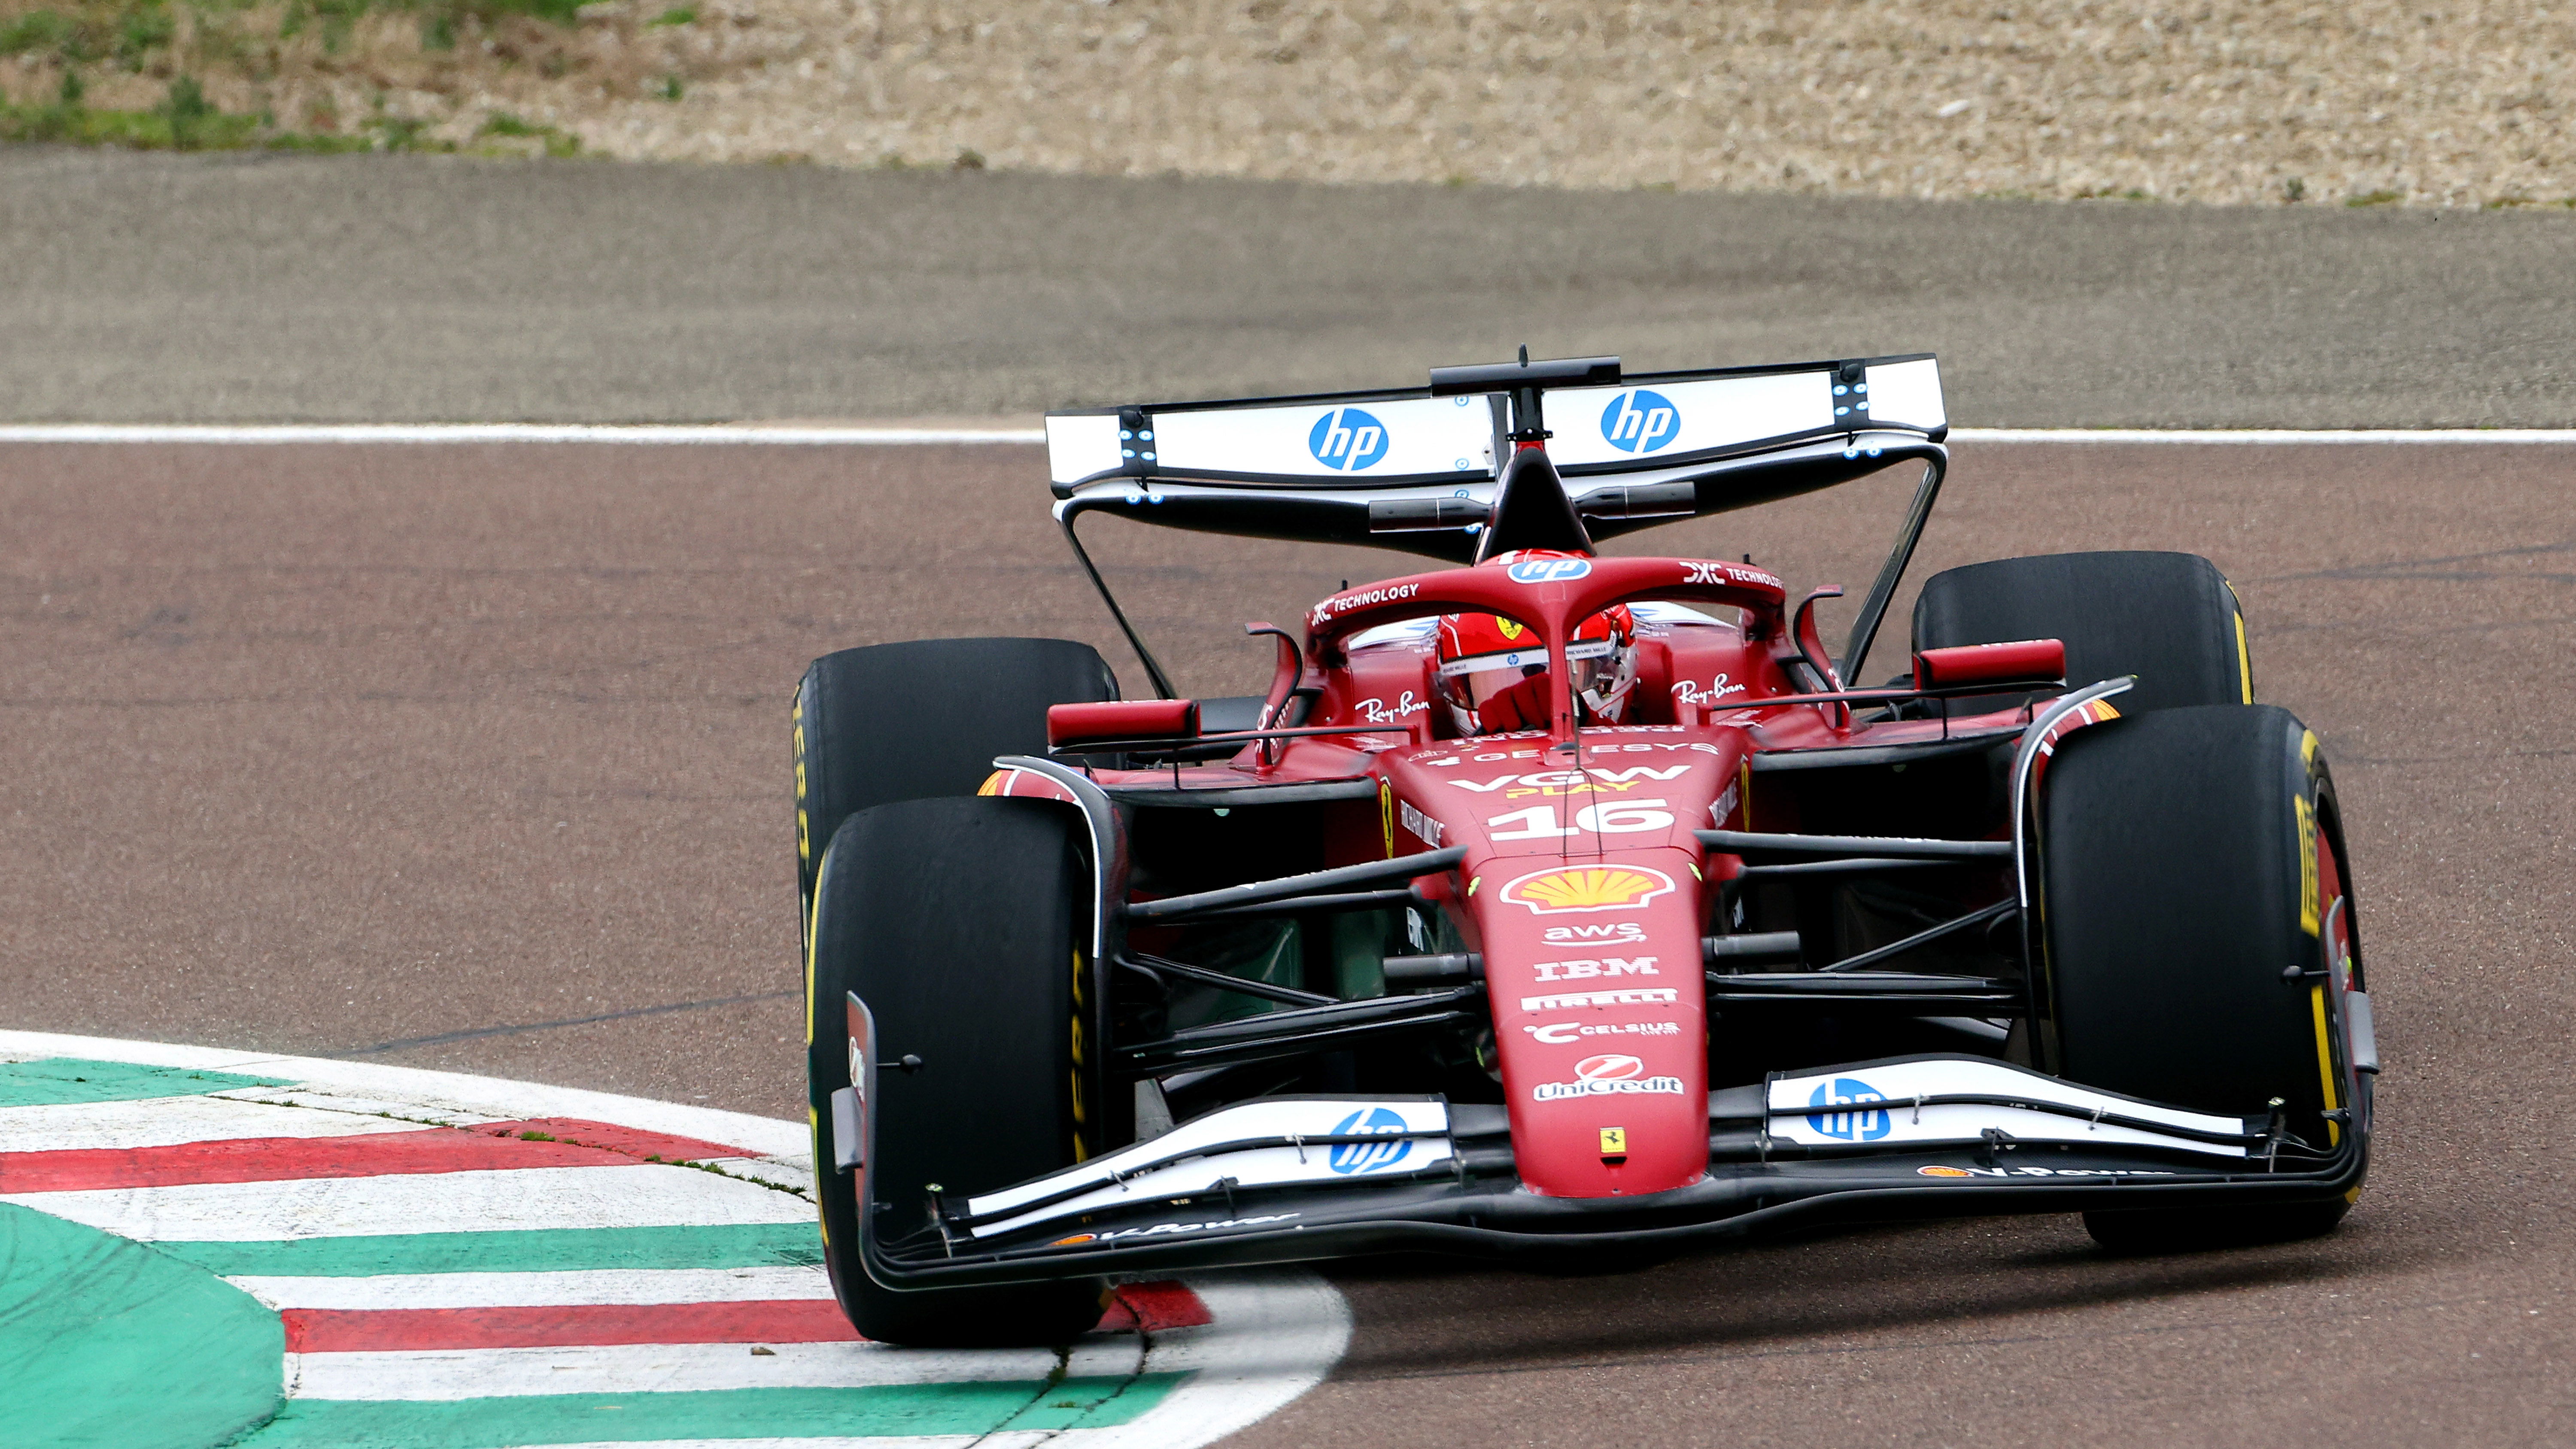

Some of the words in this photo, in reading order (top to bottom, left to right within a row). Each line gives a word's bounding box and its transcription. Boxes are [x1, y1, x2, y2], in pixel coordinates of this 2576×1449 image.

[1616, 390, 1673, 453] hp
[1318, 408, 1381, 471] hp
[1518, 559, 1584, 580] hp
[1726, 568, 1784, 589] TECHNOLO
[1334, 583, 1419, 612] TECHNOLOGY
[1671, 673, 1746, 704] Ray-Ban
[1355, 690, 1430, 723] Ray-Ban
[1473, 742, 1719, 762] GEESYS
[1447, 764, 1693, 793] VGW
[1505, 781, 1640, 799] PLAY
[1487, 798, 1676, 841] 16
[1543, 922, 1643, 940] aws
[1533, 957, 1660, 982] IBM
[1520, 988, 1678, 1012] PIRELLI
[1579, 1022, 1681, 1035] CELSIUS
[1537, 1078, 1682, 1099] UniCredit
[1822, 1078, 1880, 1141] hp
[1334, 1107, 1404, 1174] hp
